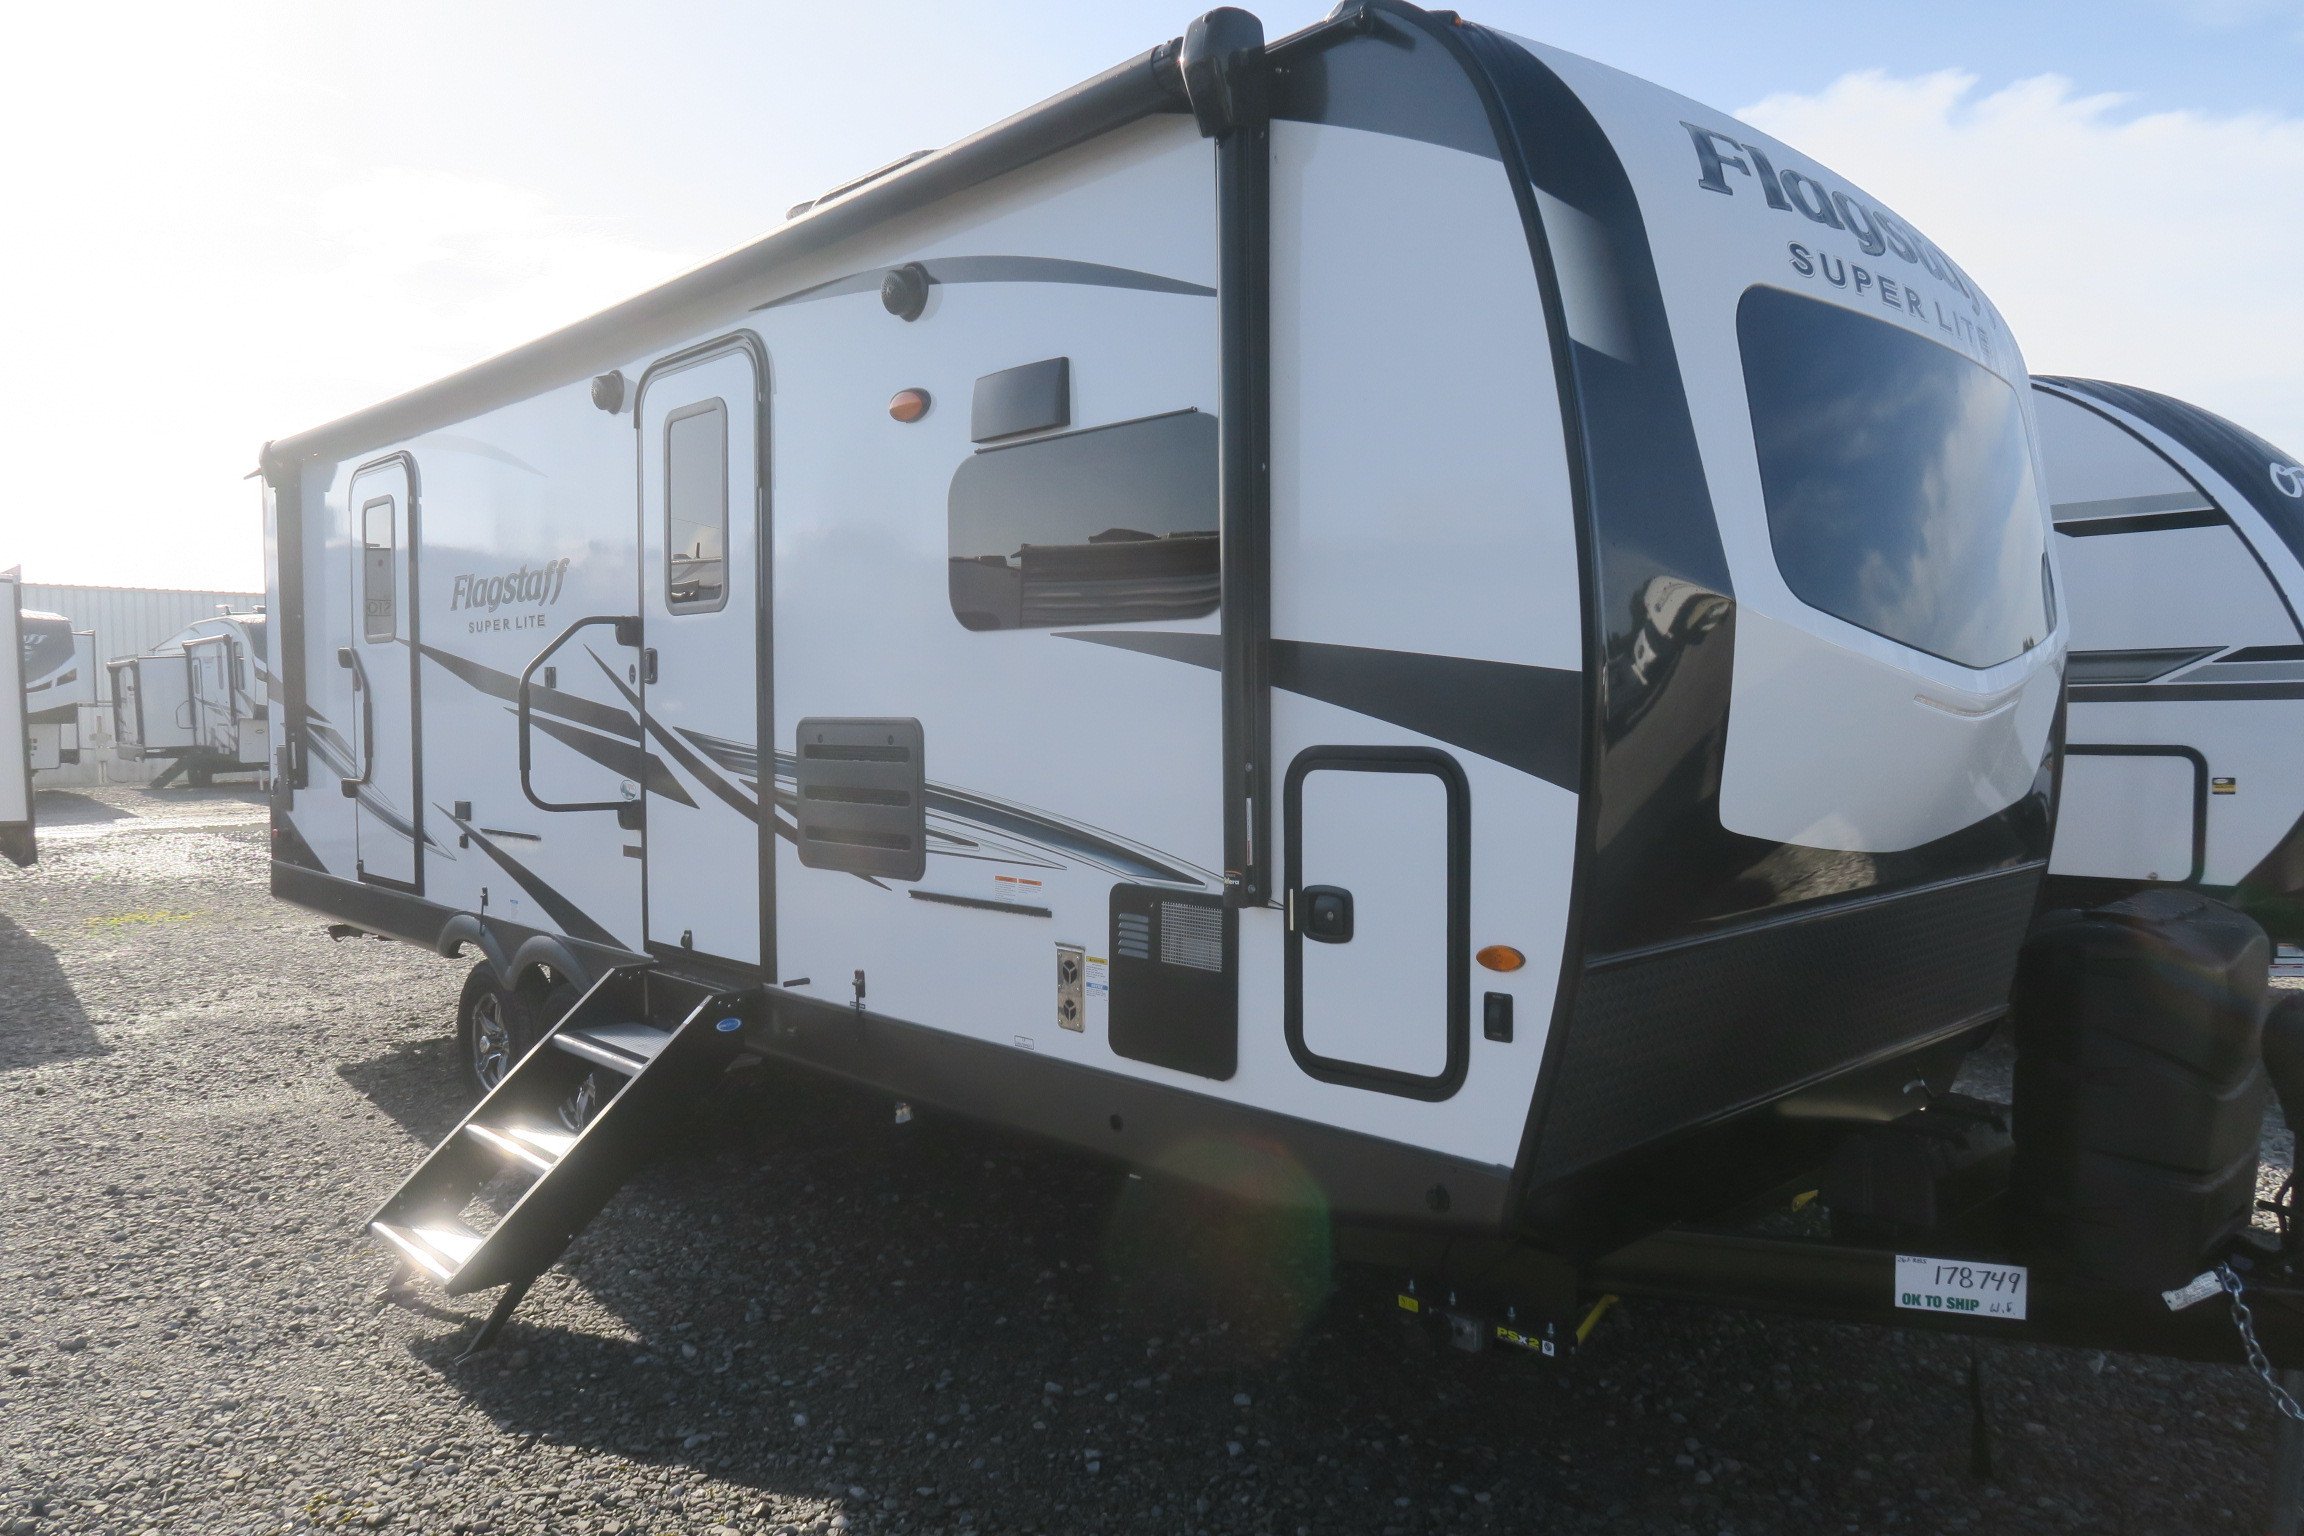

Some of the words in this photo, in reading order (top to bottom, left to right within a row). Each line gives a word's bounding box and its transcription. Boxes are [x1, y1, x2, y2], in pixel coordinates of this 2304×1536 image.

[1787, 241, 1928, 322] SUPER
[1935, 300, 1992, 360] LITE
[450, 557, 570, 613] Flagstaff
[468, 618, 510, 634] SUPER
[515, 614, 546, 631] LITE
[1935, 1265, 2021, 1294] 178749
[1902, 1292, 1921, 1307] OK
[1925, 1294, 1943, 1309] TO
[1946, 1296, 1980, 1312] SHIP
